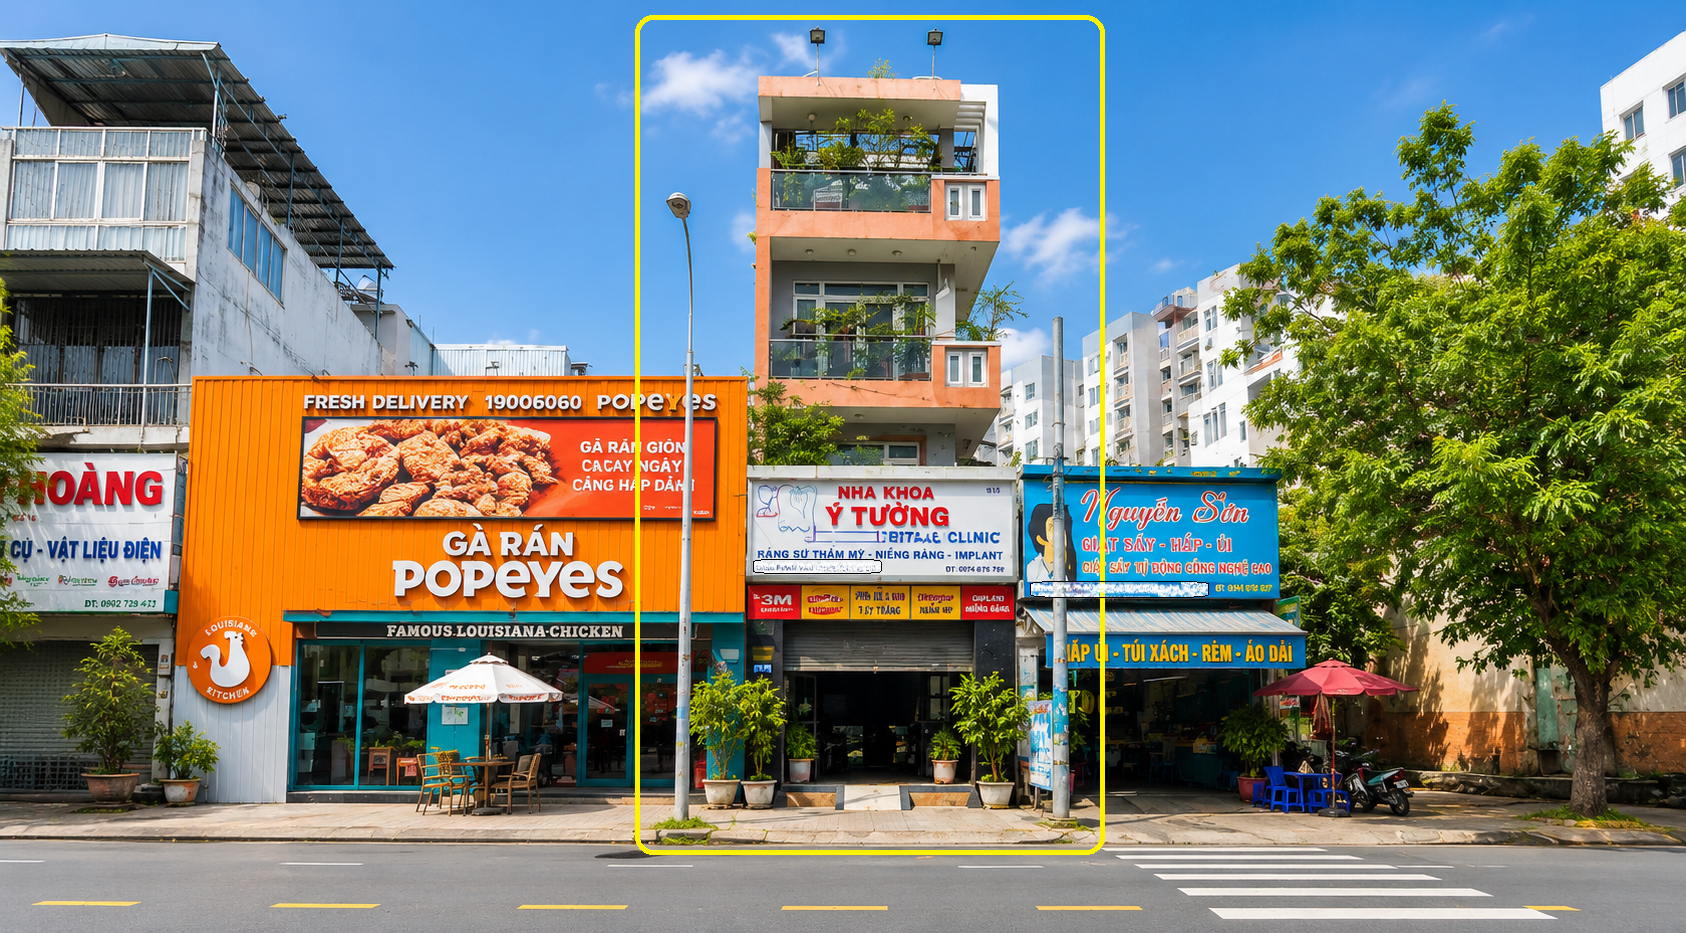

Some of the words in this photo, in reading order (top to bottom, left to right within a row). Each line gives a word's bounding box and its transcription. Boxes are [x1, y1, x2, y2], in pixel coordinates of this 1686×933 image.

[303, 394, 365, 410] FRESH
[372, 394, 469, 410] DELIVERY
[485, 394, 582, 410] 19006060
[837, 486, 877, 499] NHA
[883, 486, 935, 500] KHOA
[825, 502, 843, 526] Ý
[442, 523, 491, 557] GÀ
[500, 524, 574, 557] RÁN
[955, 551, 1003, 560] IMPLANT
[761, 594, 792, 606] 3M
[1122, 639, 1146, 662] TÚI
[1149, 640, 1189, 662] XÁCH
